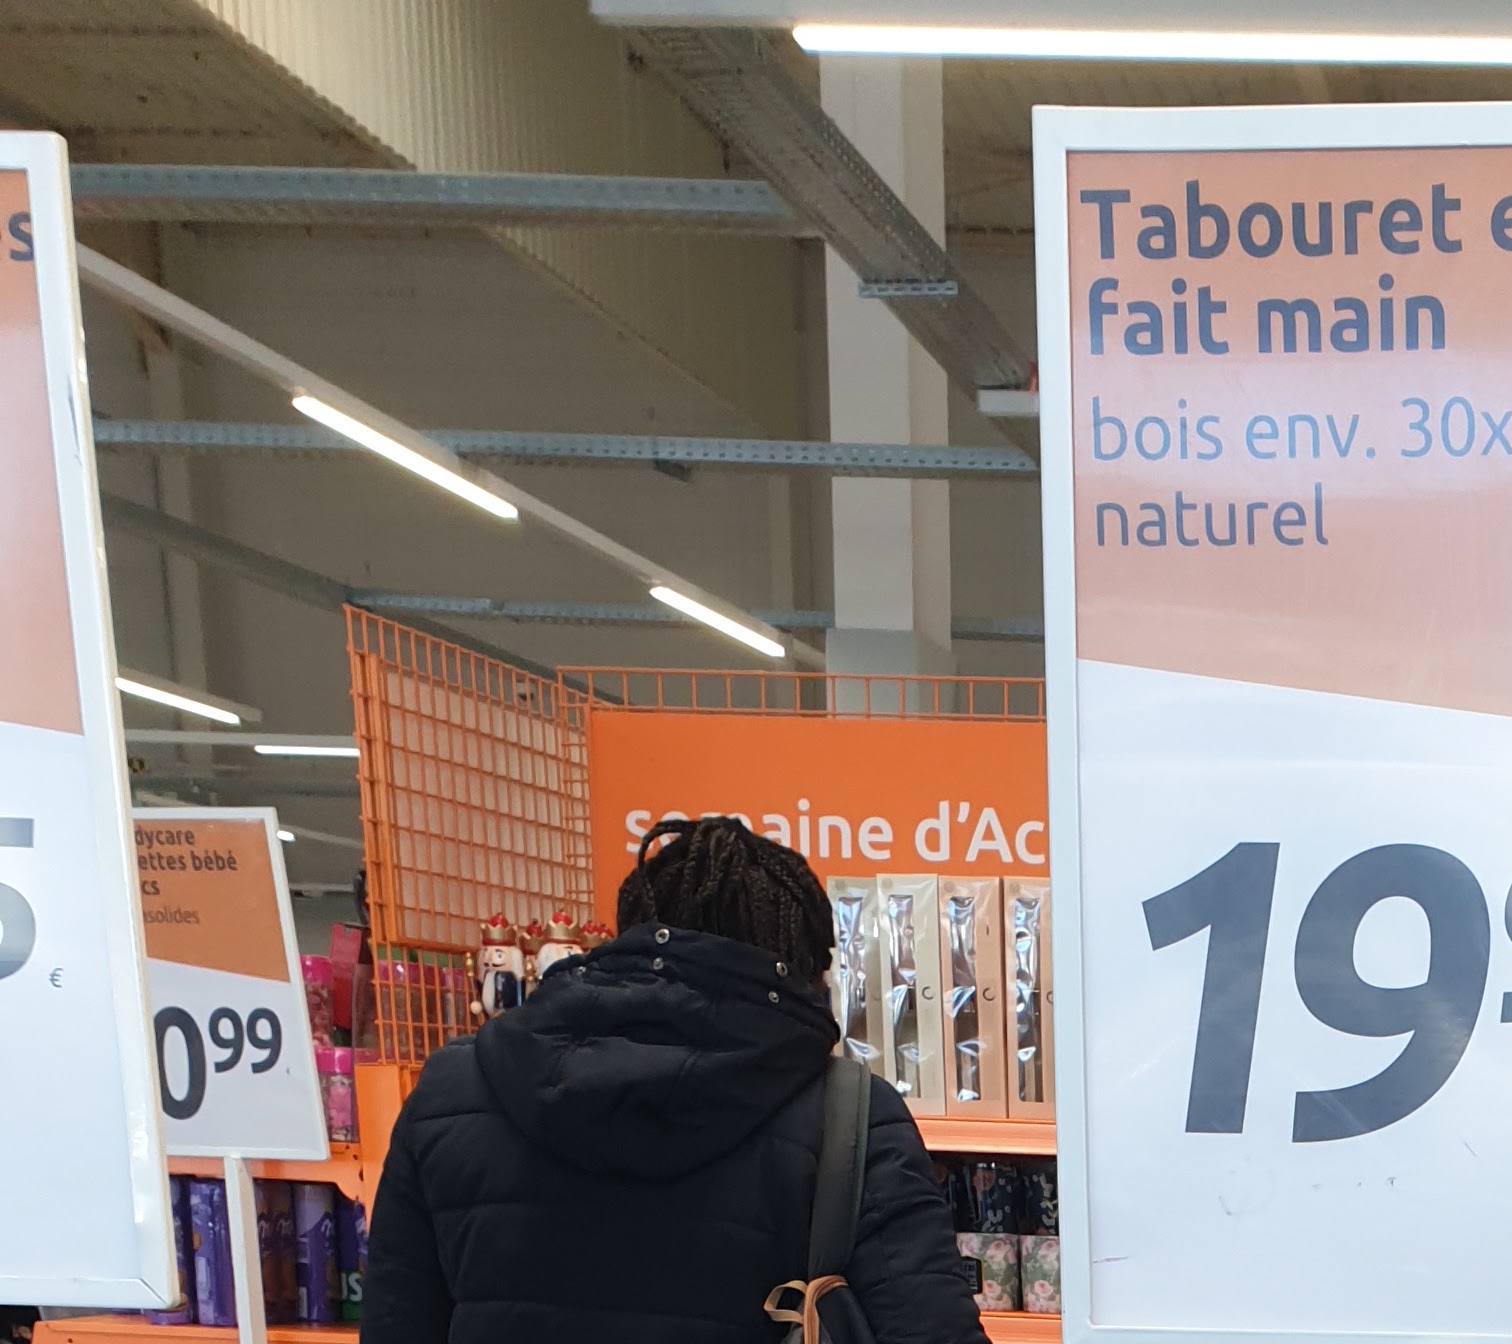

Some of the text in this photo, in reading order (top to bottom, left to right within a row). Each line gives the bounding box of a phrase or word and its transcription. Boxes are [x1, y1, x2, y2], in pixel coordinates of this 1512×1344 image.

[1080, 179, 1463, 260] Tabouret
[1087, 273, 1446, 356] fait main
[1092, 396, 1223, 461] bois
[1245, 414, 1376, 460] env.
[1094, 484, 1329, 548] naturel
[190, 848, 238, 872] bébé
[625, 798, 1047, 864] saine d'Ac
